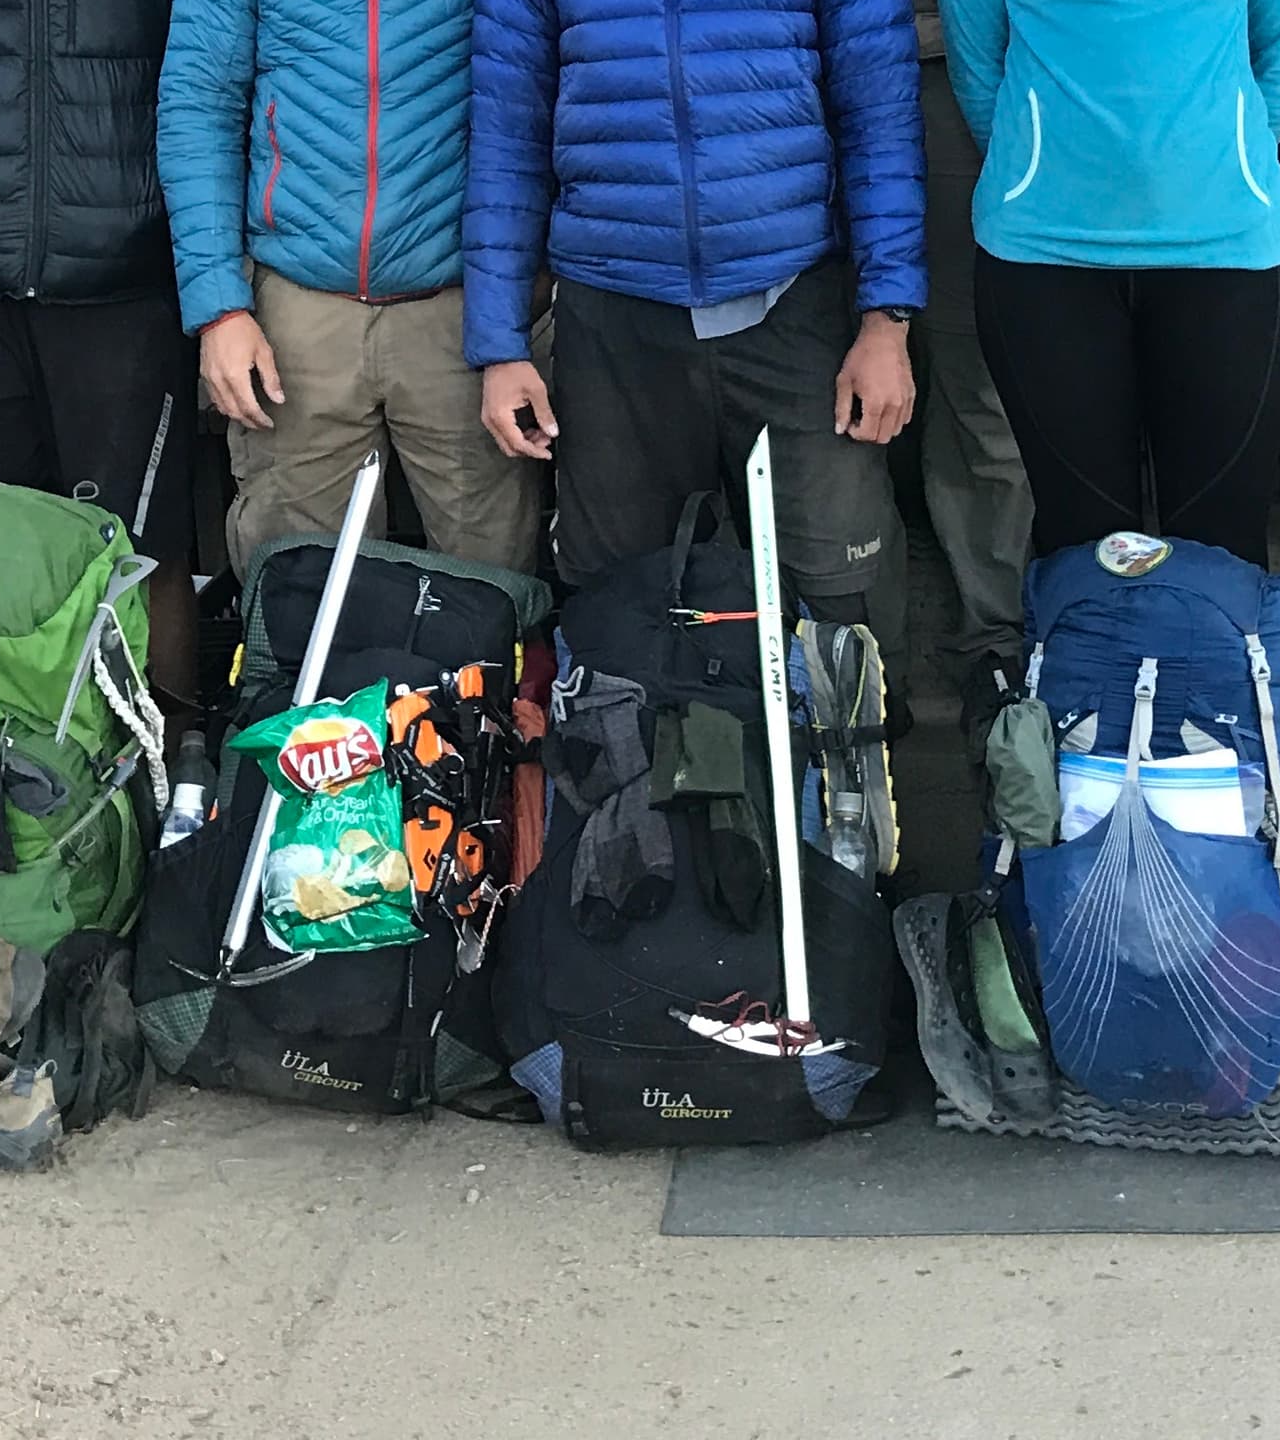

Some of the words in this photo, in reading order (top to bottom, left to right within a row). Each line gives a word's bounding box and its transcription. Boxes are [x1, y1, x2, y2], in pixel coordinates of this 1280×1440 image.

[769, 635, 783, 702] CAMP
[323, 806, 365, 824] Onion
[294, 1071, 363, 1091] CIRCUIT
[660, 1108, 733, 1118] CIRCUIT
